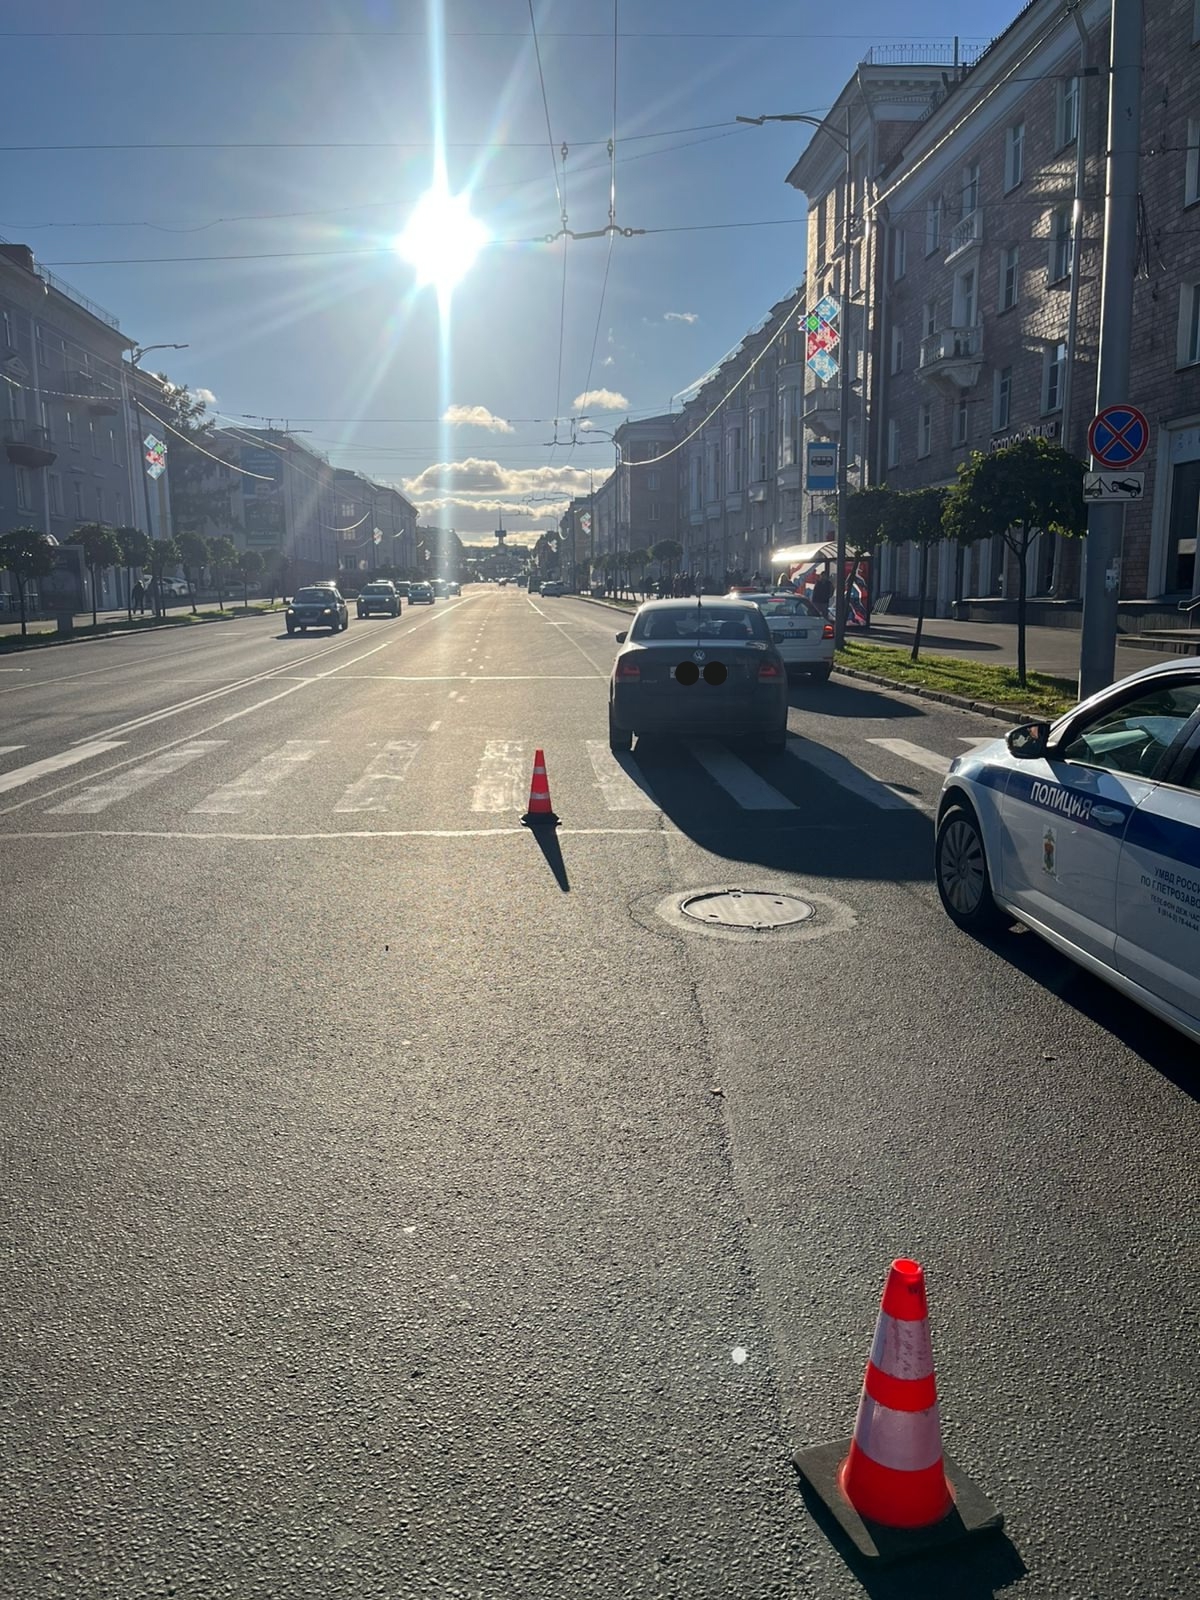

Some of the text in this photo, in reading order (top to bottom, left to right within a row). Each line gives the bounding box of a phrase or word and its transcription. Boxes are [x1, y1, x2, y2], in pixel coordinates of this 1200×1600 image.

[1030, 781, 1093, 820] ПОЛИЦИЯ
[1140, 875, 1151, 888] ПО
[1154, 866, 1175, 884] УМВД
